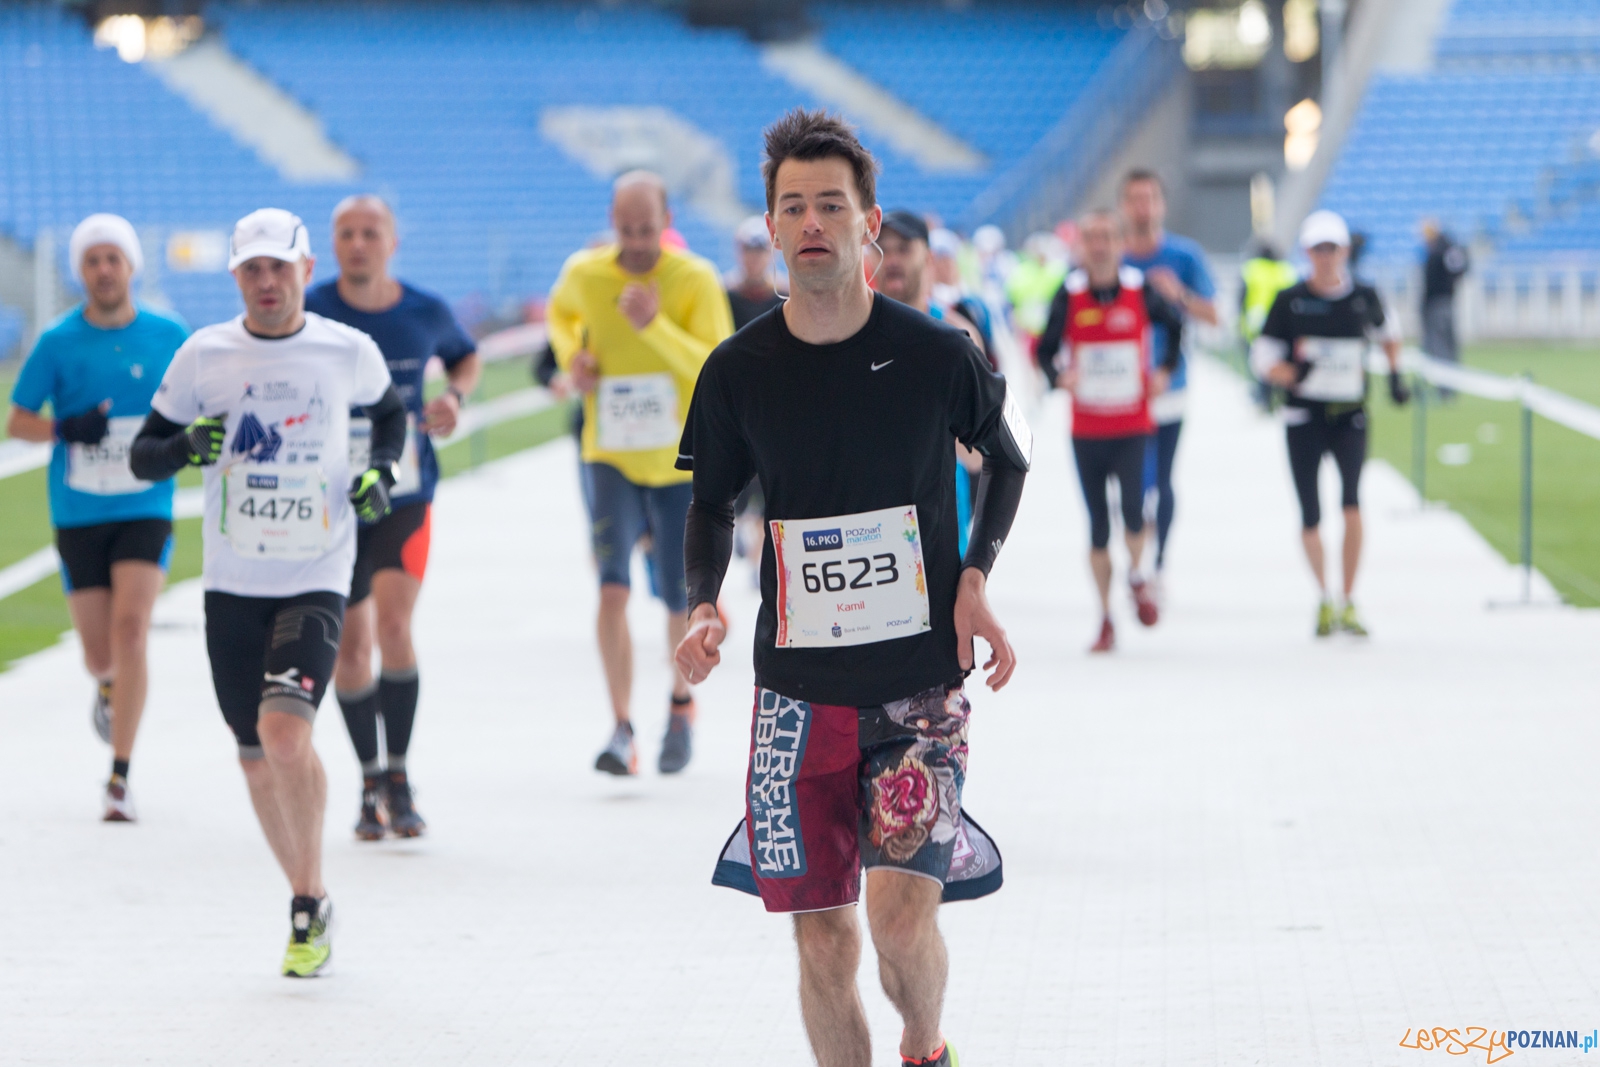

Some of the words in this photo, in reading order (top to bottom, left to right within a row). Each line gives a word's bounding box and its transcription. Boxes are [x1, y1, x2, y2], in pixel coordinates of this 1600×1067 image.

[239, 496, 312, 521] 4476
[846, 533, 882, 544] maraton
[802, 552, 899, 593] 6623
[836, 601, 866, 612] Kamil
